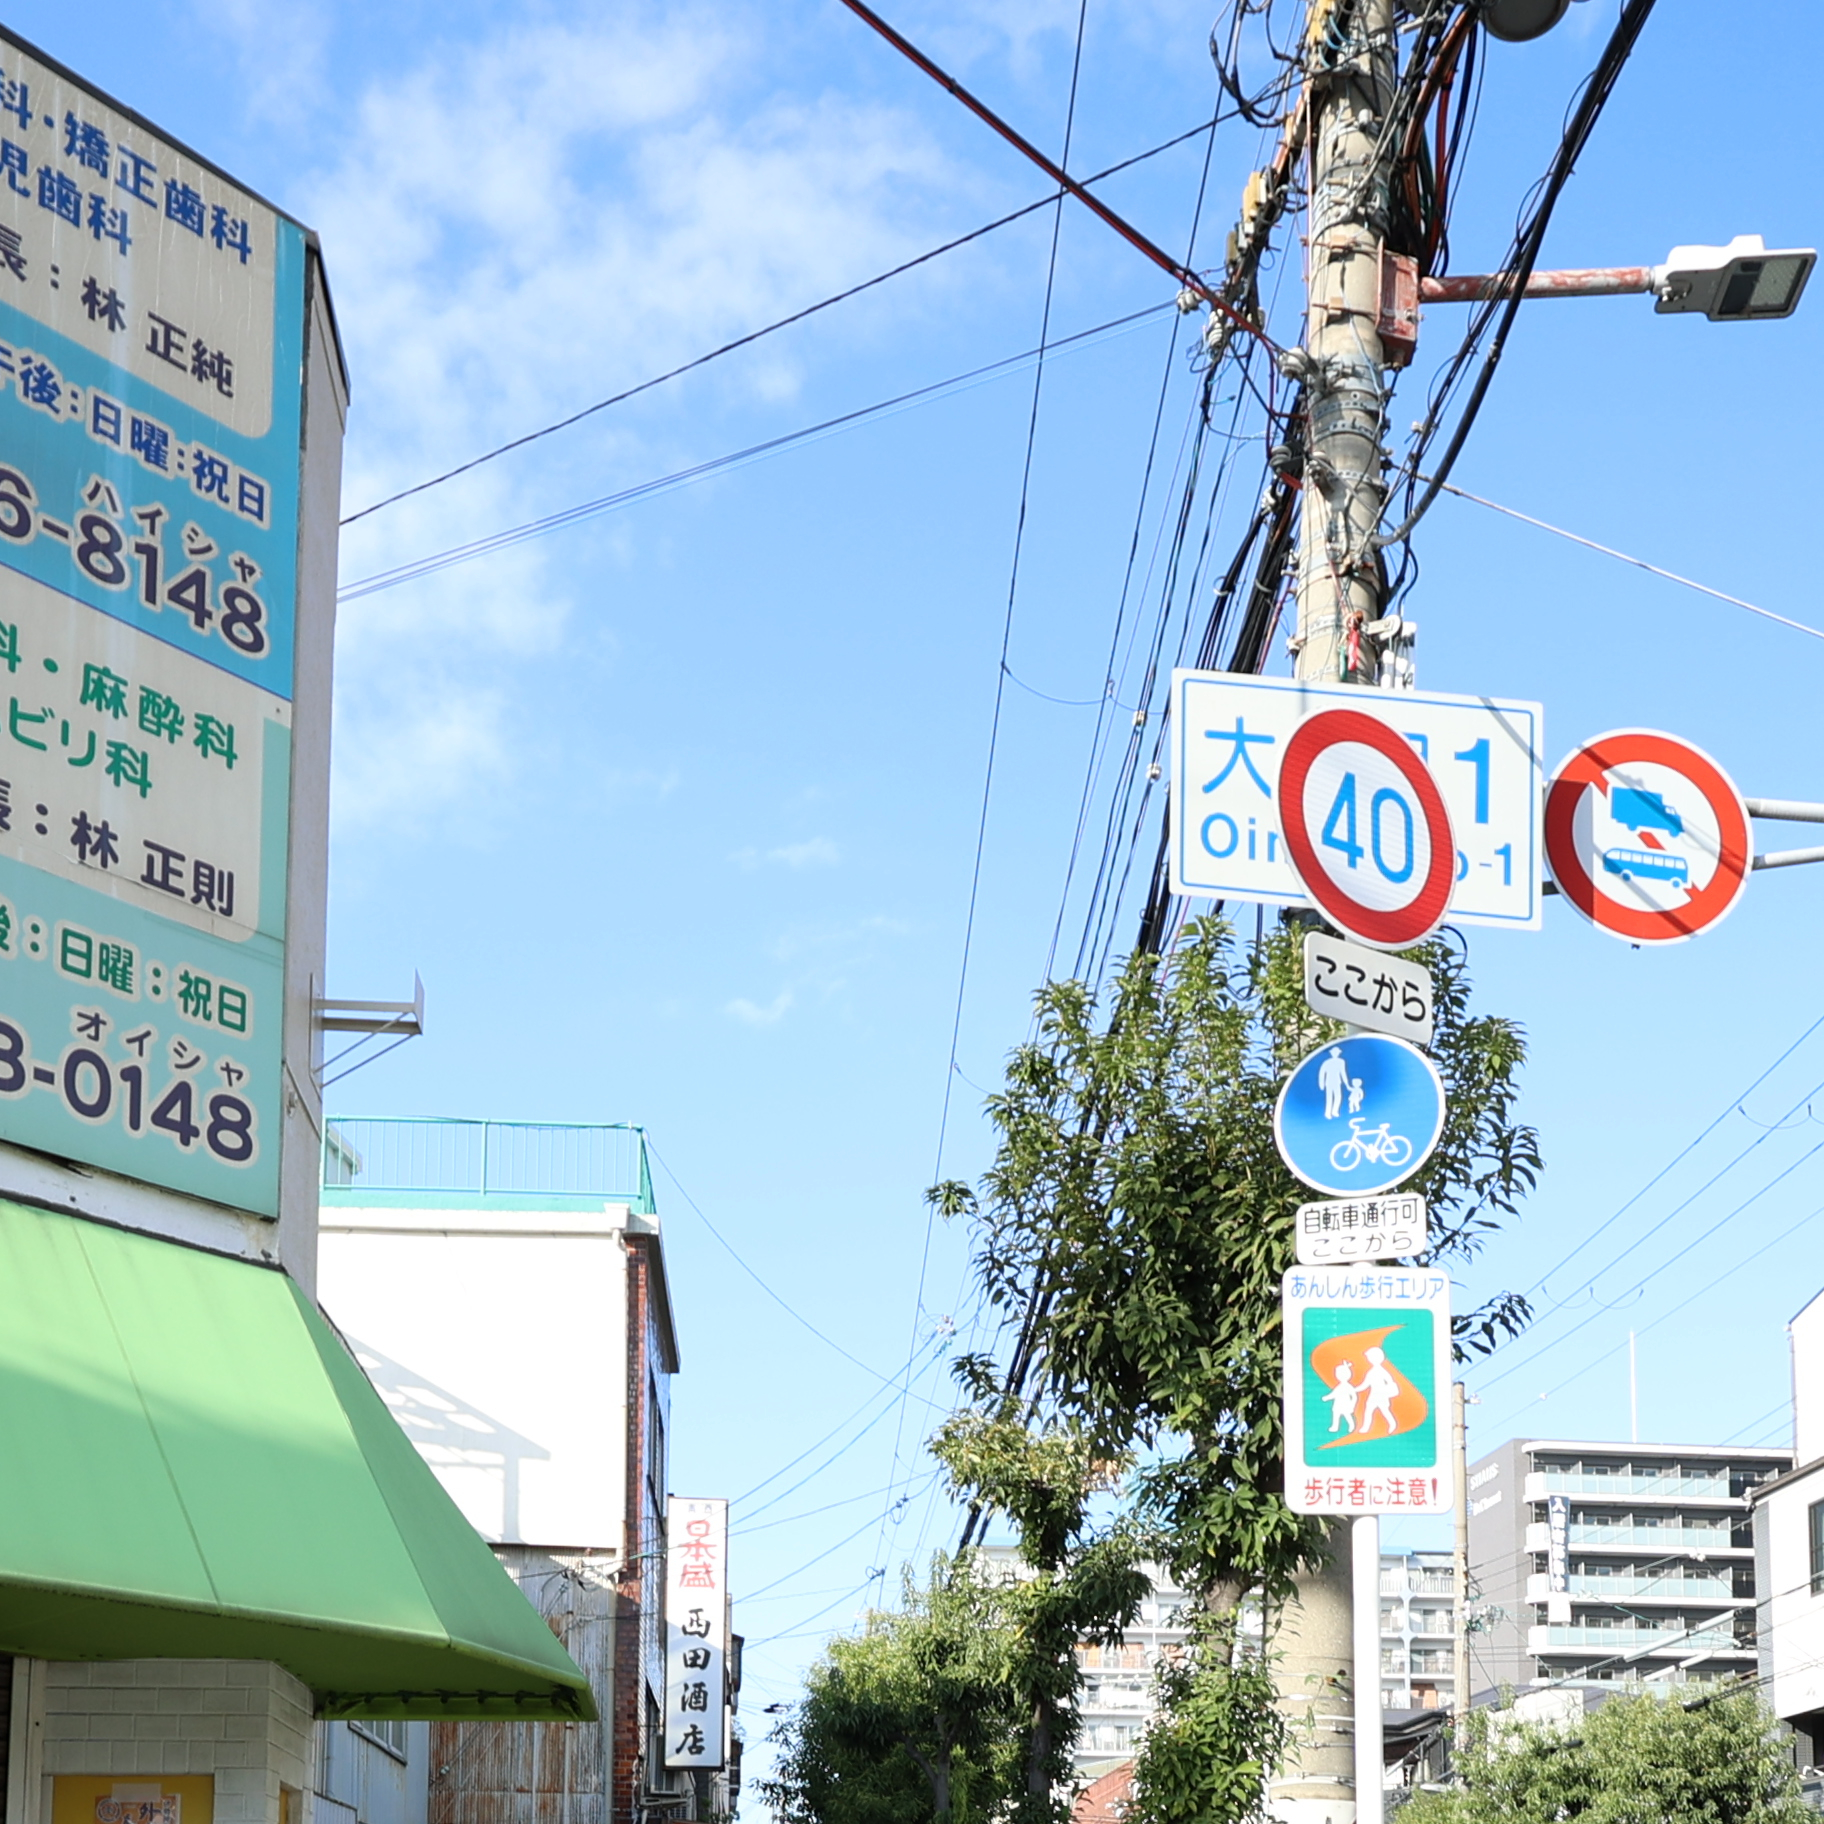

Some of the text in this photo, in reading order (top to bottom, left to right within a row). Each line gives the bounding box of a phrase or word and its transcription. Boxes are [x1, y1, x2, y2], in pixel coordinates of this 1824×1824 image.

[145, 310, 234, 399] 正純
[1321, 770, 1415, 884] 40
[140, 839, 235, 918] 正則
[1314, 954, 1427, 1022] ここから
[76, 1011, 243, 1087] オイシャ
[1304, 1197, 1419, 1235] 自転車通行可
[1312, 1230, 1413, 1257] ここから
[1290, 1275, 1445, 1300] あんしん歩行エリア
[679, 1519, 717, 1590] 日本盛
[675, 1607, 711, 1757] 西田酒店
